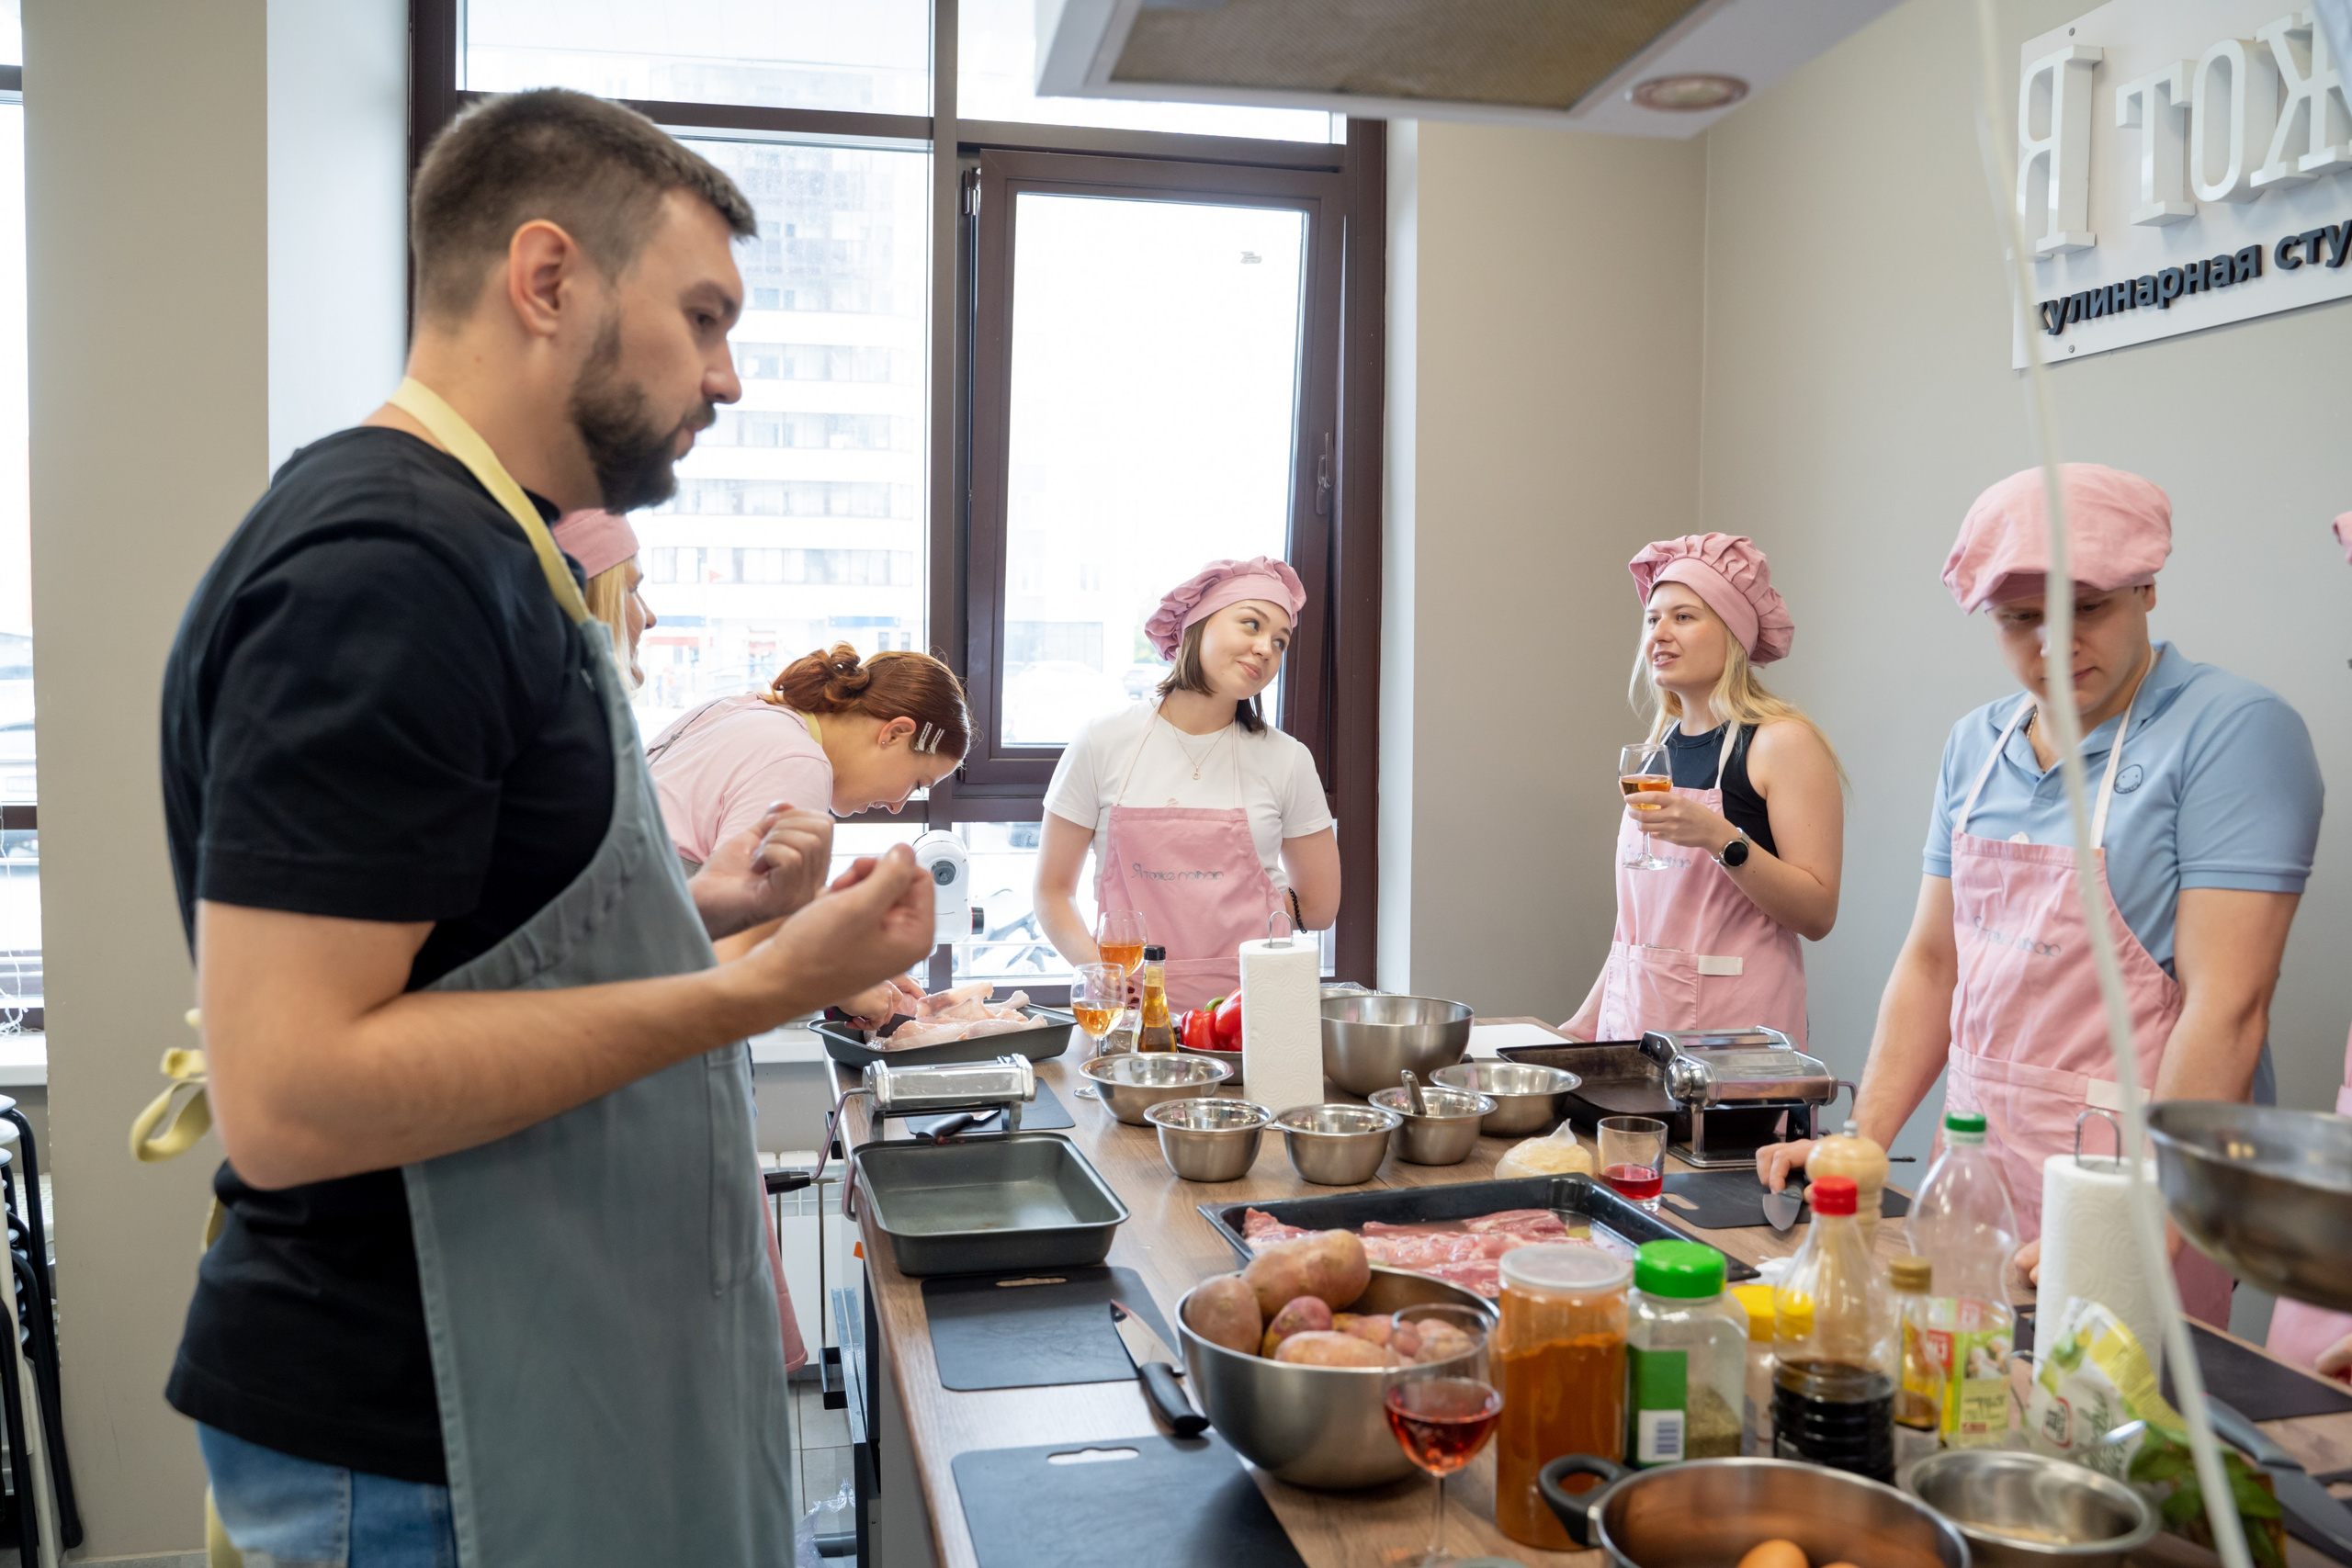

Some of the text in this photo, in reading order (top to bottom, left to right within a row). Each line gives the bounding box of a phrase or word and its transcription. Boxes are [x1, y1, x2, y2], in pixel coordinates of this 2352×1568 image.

[2008, 44, 2103, 262] Я
[1131, 863, 1225, 881] Я тоже повар
